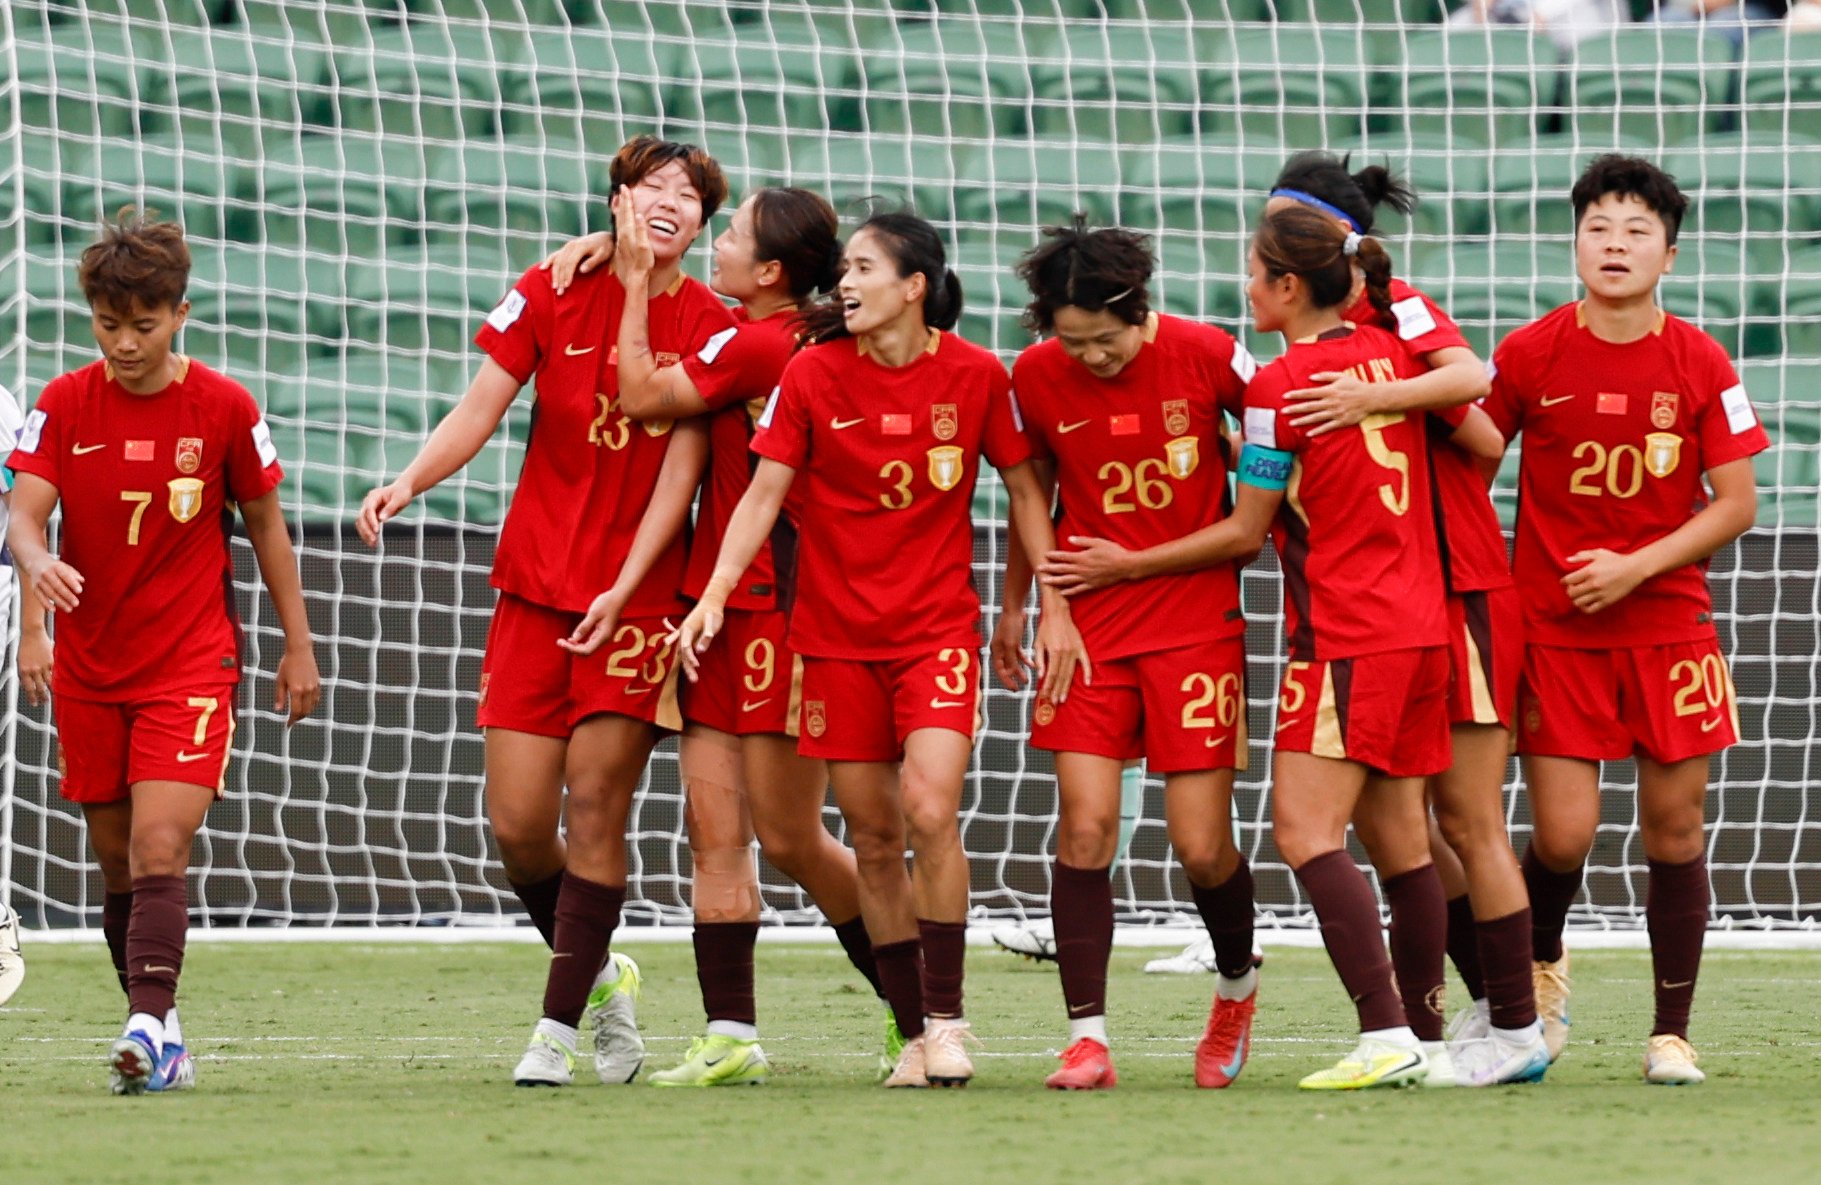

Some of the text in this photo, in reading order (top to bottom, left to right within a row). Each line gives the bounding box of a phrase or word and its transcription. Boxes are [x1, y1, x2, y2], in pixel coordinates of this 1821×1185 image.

[879, 460, 914, 510] 3
[1098, 457, 1174, 515] 26
[1359, 412, 1410, 517] 5
[1569, 440, 1644, 499] 20
[120, 491, 152, 546] 7
[606, 625, 672, 684] 23
[744, 637, 775, 692] 9
[935, 647, 971, 696] 3
[1180, 672, 1240, 729] 26
[1280, 660, 1310, 713] 5
[1669, 653, 1725, 718] 20
[187, 697, 218, 747] 7
